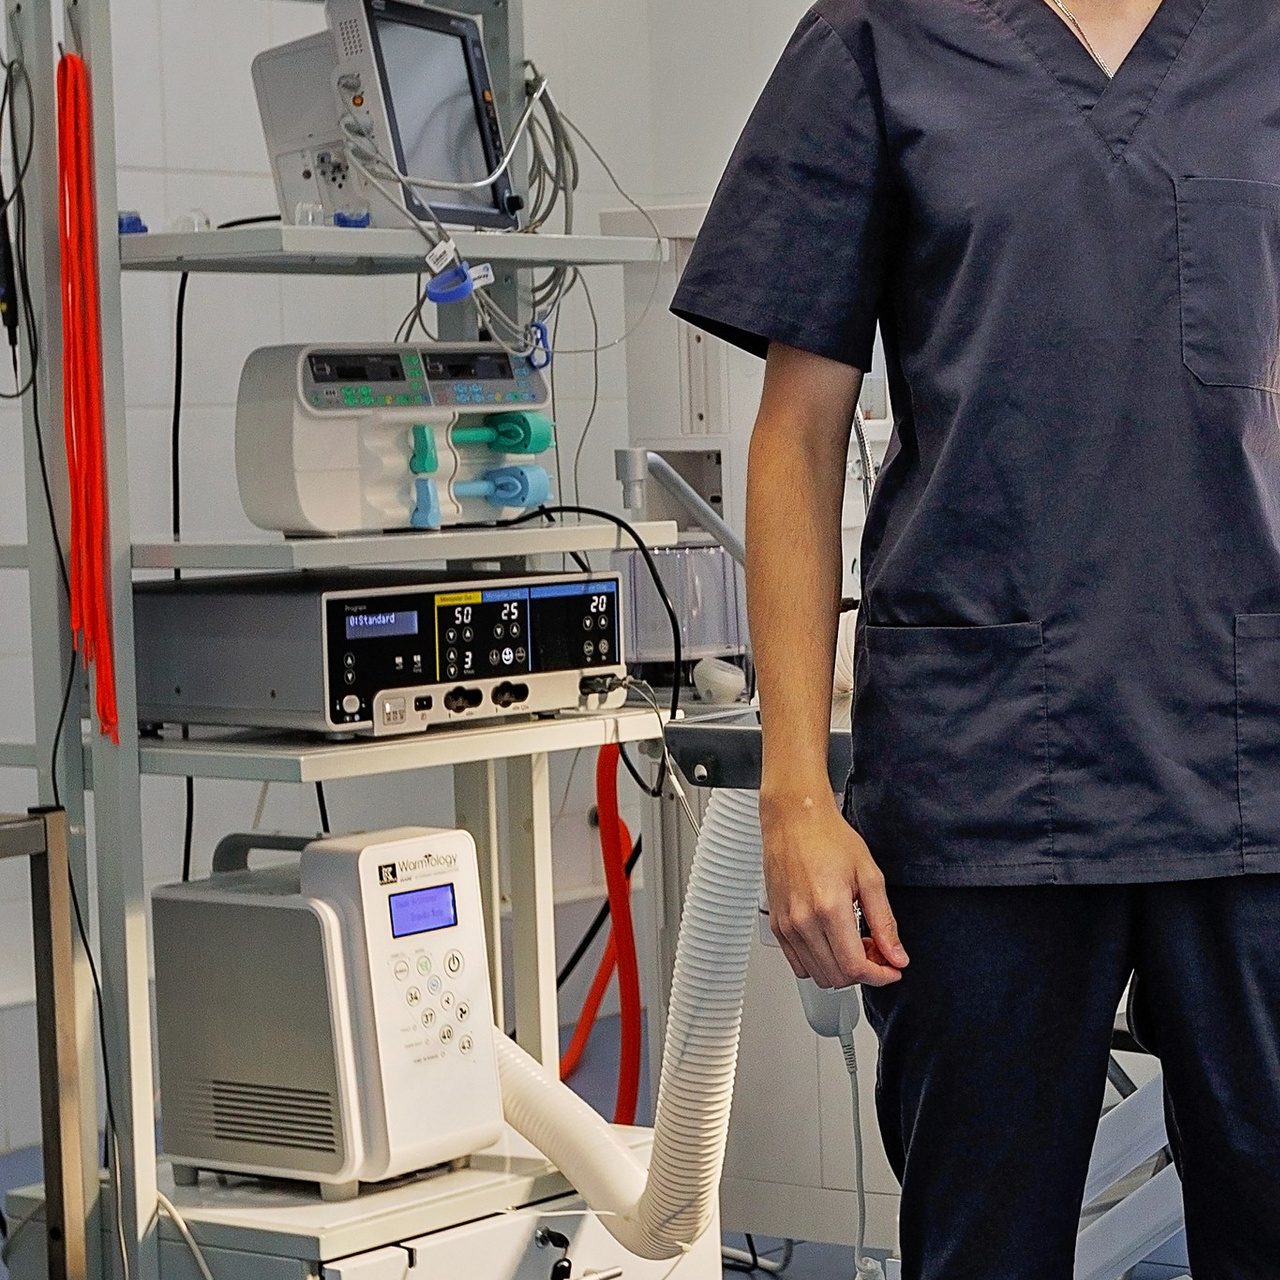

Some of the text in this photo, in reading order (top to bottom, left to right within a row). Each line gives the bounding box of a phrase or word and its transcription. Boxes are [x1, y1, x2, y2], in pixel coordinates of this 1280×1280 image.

[501, 602, 518, 620] 25
[590, 595, 607, 613] 20
[454, 606, 472, 625] 50
[464, 651, 472, 669] 3
